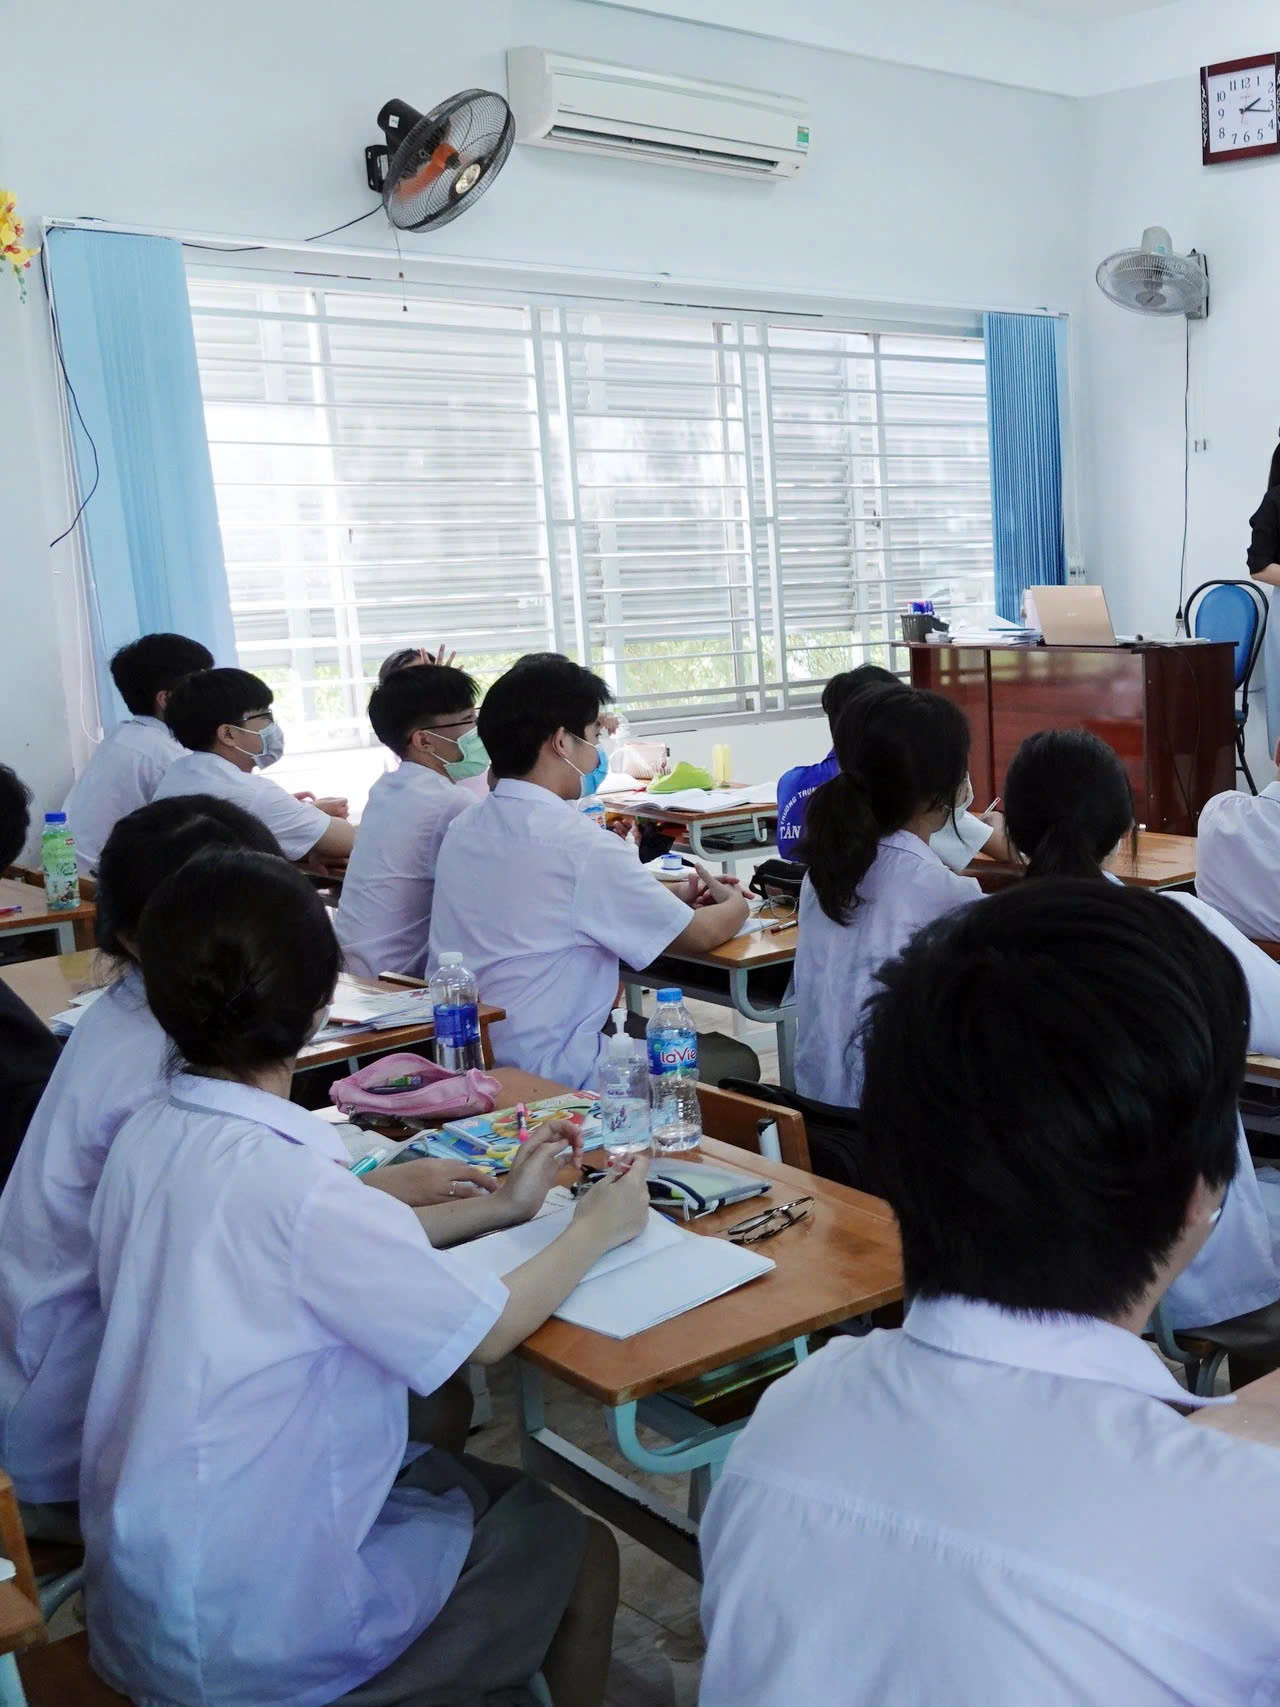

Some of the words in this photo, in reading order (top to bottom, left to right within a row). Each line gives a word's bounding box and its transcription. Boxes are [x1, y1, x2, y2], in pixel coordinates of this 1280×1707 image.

[1229, 80, 1237, 91] 11
[1241, 77, 1251, 89] 12
[1267, 81, 1274, 93] 2
[1216, 91, 1226, 102] 10
[1218, 108, 1225, 120] 9
[1268, 119, 1274, 130] 4
[1219, 127, 1226, 139] 8
[1232, 133, 1238, 144] 7
[1243, 130, 1250, 143] 6
[1257, 128, 1264, 140] 5
[780, 821, 801, 839] TÂN
